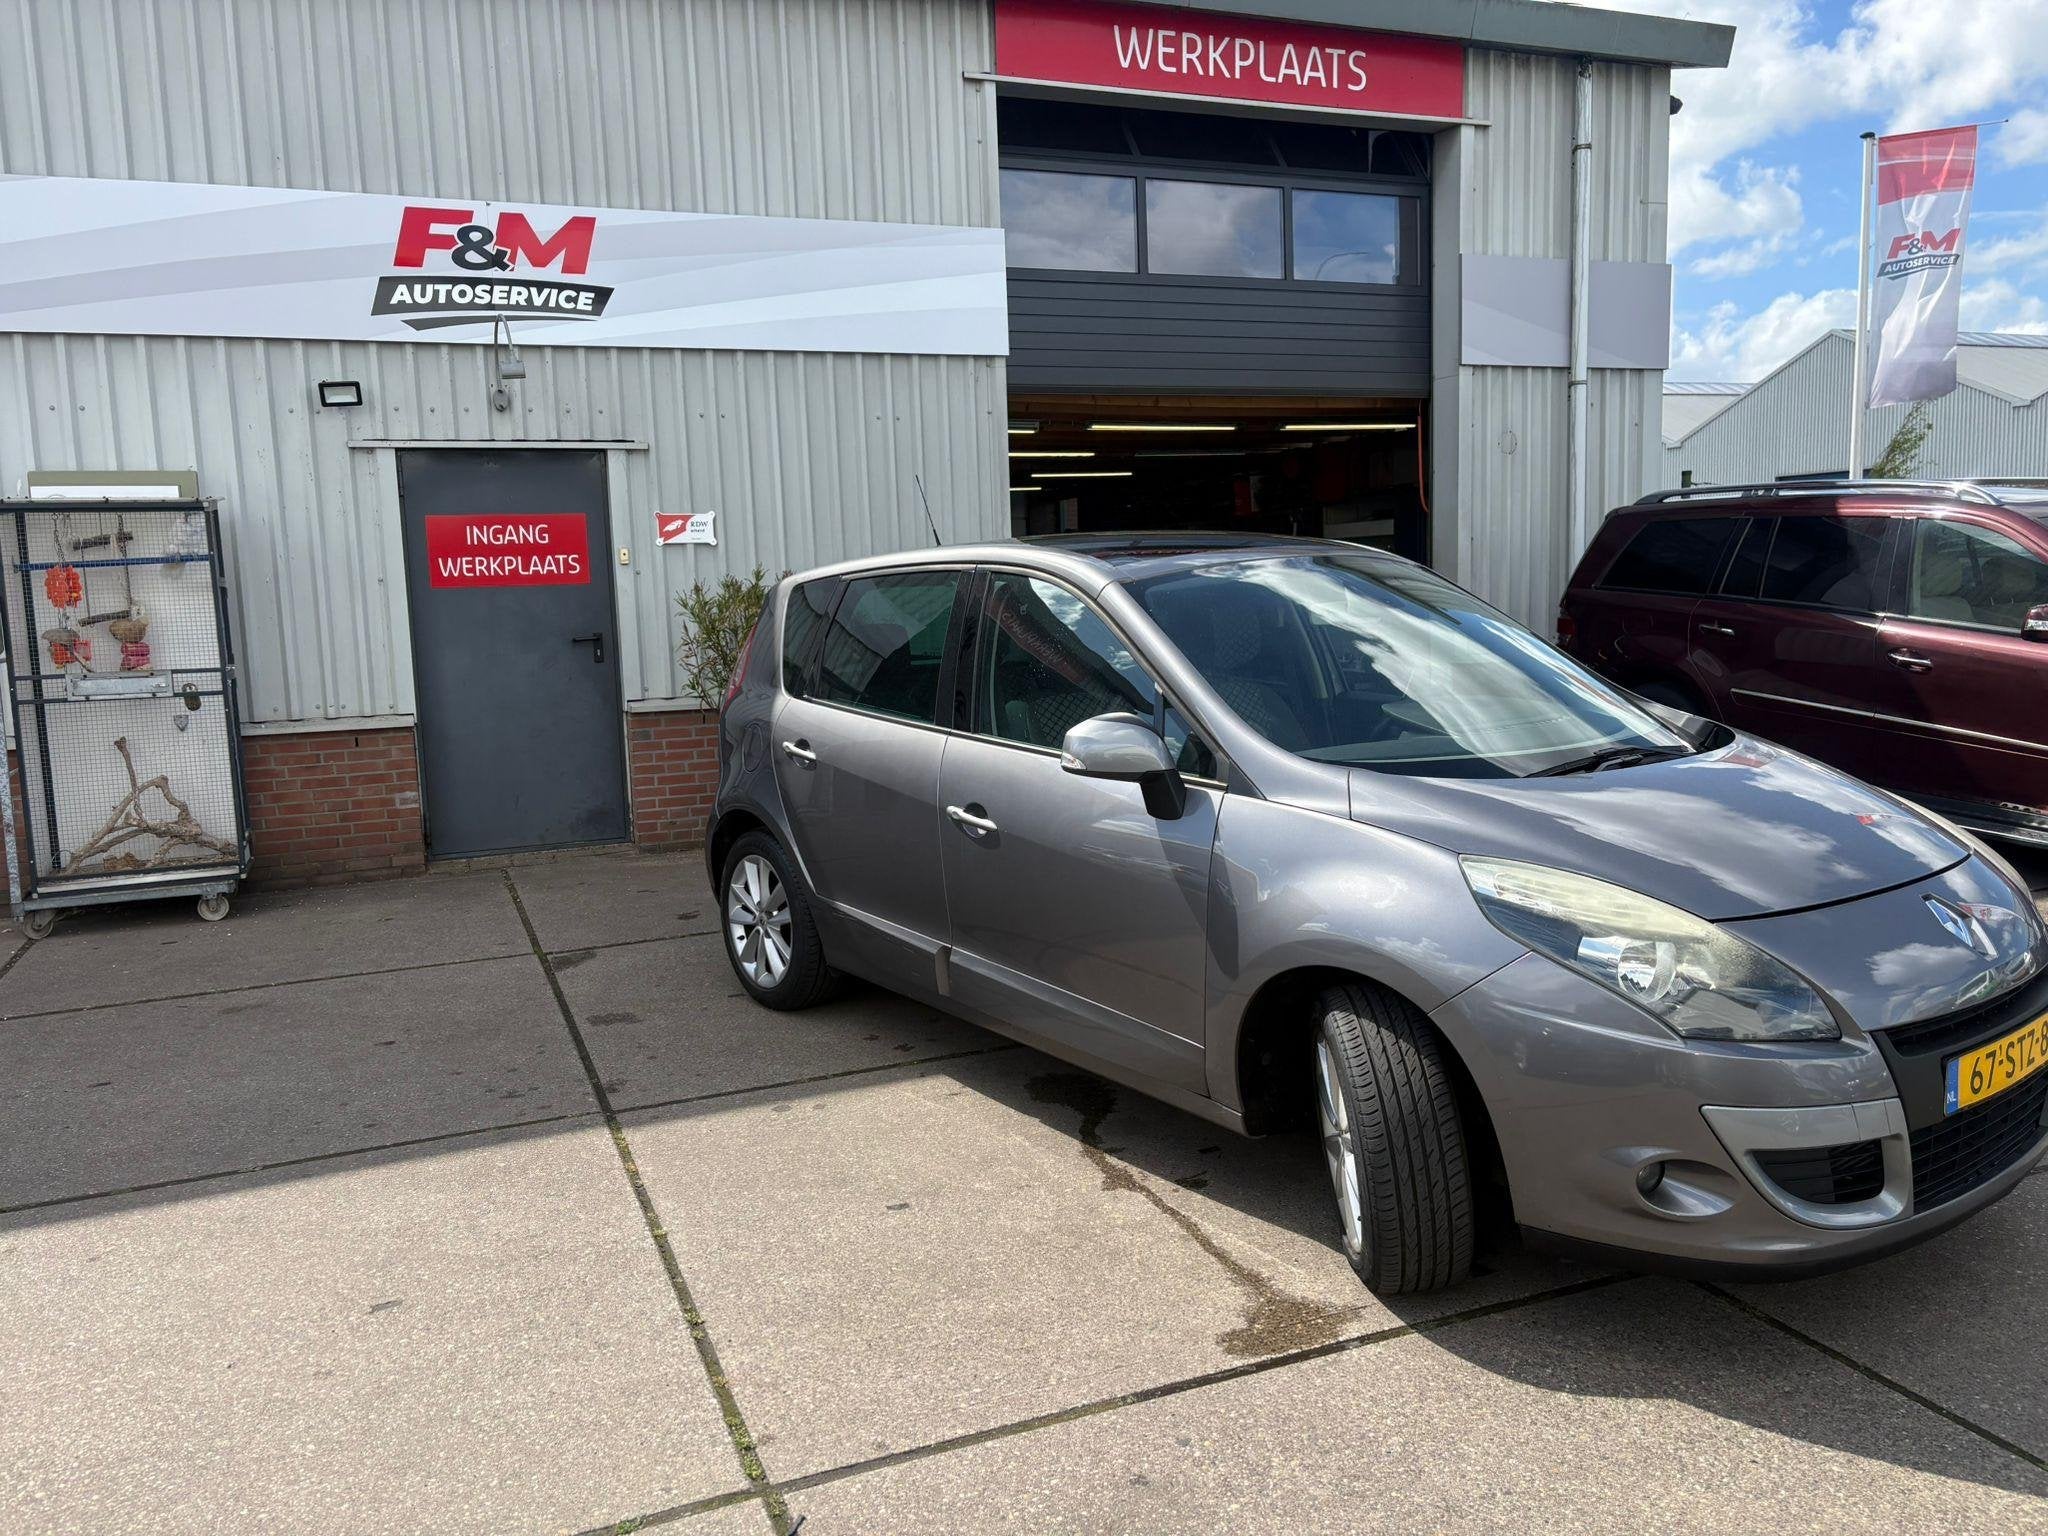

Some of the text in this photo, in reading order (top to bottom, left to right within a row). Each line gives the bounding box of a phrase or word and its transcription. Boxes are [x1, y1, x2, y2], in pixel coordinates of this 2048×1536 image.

[1113, 24, 1367, 91] WERKPLAATS
[393, 206, 597, 275] F&M
[1886, 228, 1961, 259] F&M
[1883, 256, 1955, 273] AUTOSERVICE
[389, 283, 596, 311] AUTOSERVICE
[466, 524, 549, 546] INGANG
[438, 554, 581, 578] WERKPLAATS
[1946, 1090, 1957, 1104] NL
